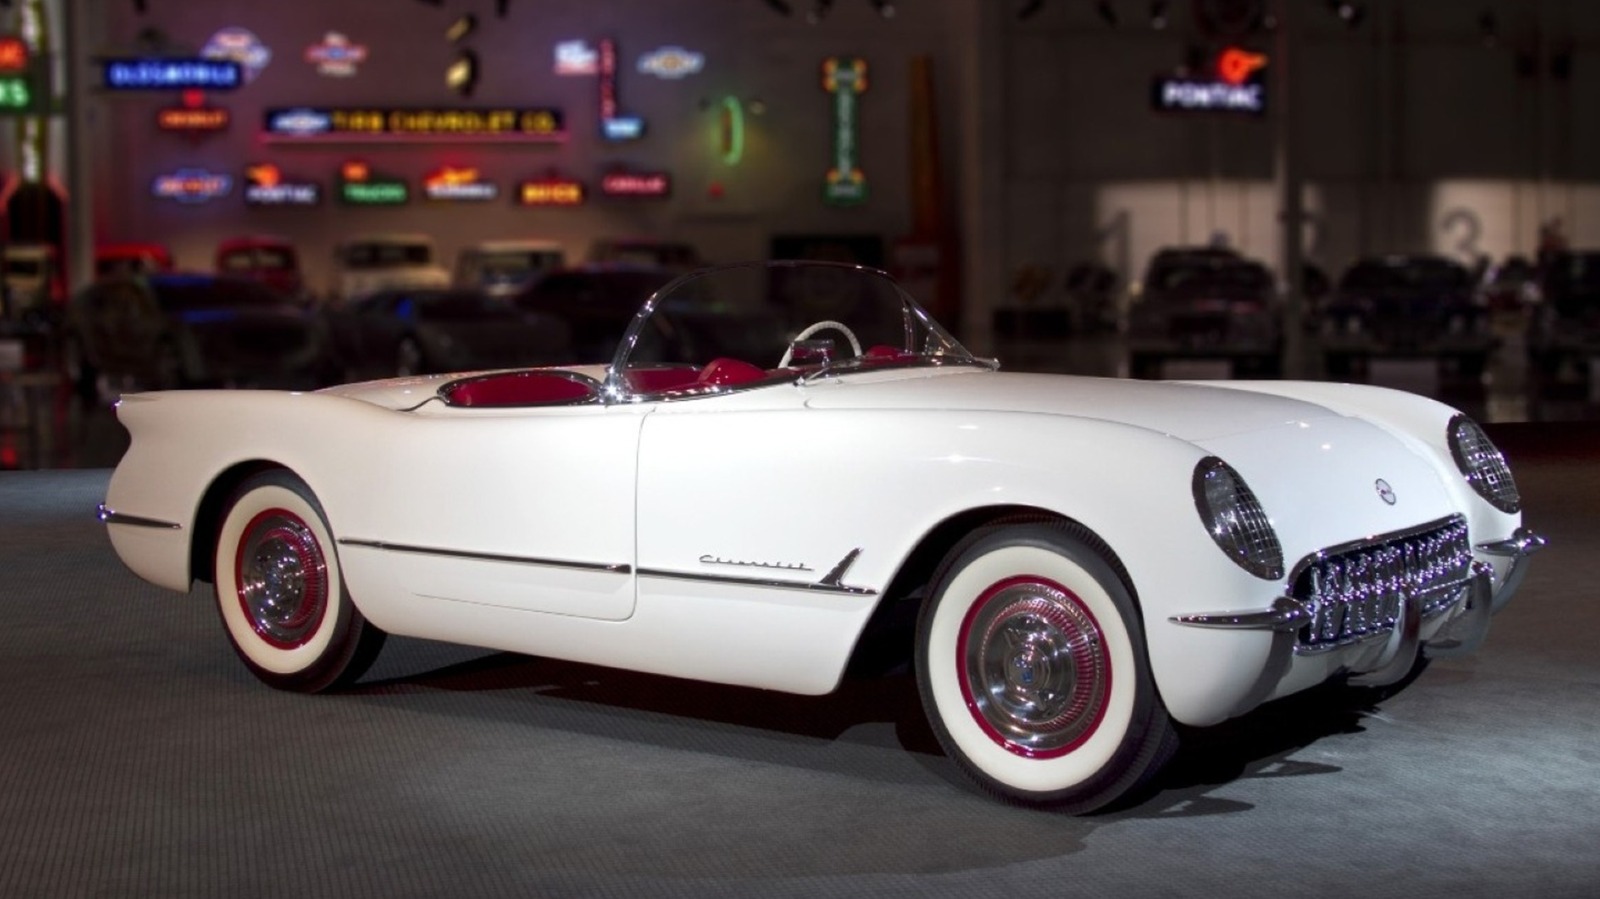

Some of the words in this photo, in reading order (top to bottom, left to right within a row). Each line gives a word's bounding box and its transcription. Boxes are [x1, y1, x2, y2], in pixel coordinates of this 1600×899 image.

[1163, 81, 1263, 110] PONTIAC
[389, 109, 516, 133] CHEVROLET
[521, 181, 582, 205] BUICK
